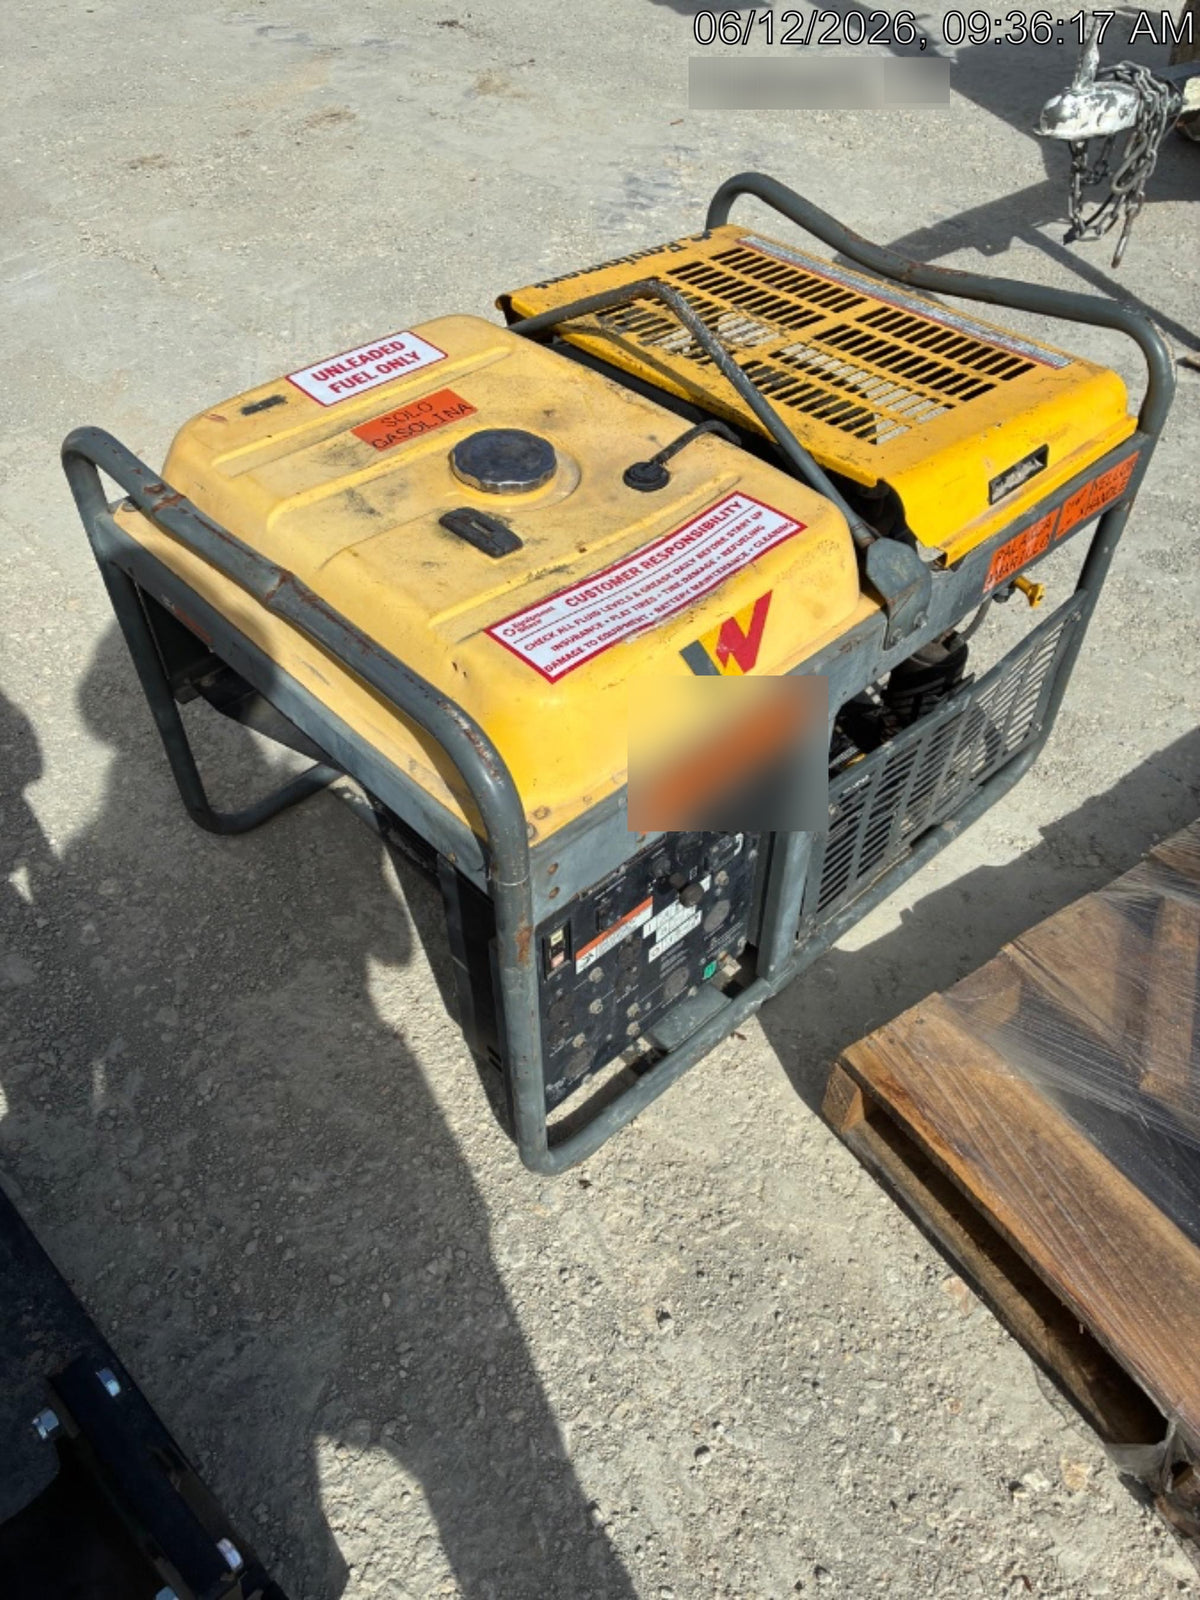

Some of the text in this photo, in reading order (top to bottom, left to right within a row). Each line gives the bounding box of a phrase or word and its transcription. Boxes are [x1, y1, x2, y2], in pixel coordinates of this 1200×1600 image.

[311, 340, 406, 382] UNLEADED
[328, 350, 422, 394] FUEL ONLY
[372, 403, 473, 450] GASOLINA
[380, 401, 433, 428] SOLO
[562, 500, 745, 608] CUSTOMER RESPONSIBILITY
[521, 631, 559, 652] CHECK
[554, 621, 577, 635] ALL
[572, 608, 603, 626] FLUID
[669, 557, 698, 575] DAILY
[693, 535, 730, 559] BEFORE
[724, 518, 753, 538] START
[748, 509, 766, 521] UP
[542, 645, 586, 673] DAMAGE
[582, 637, 600, 649] TO
